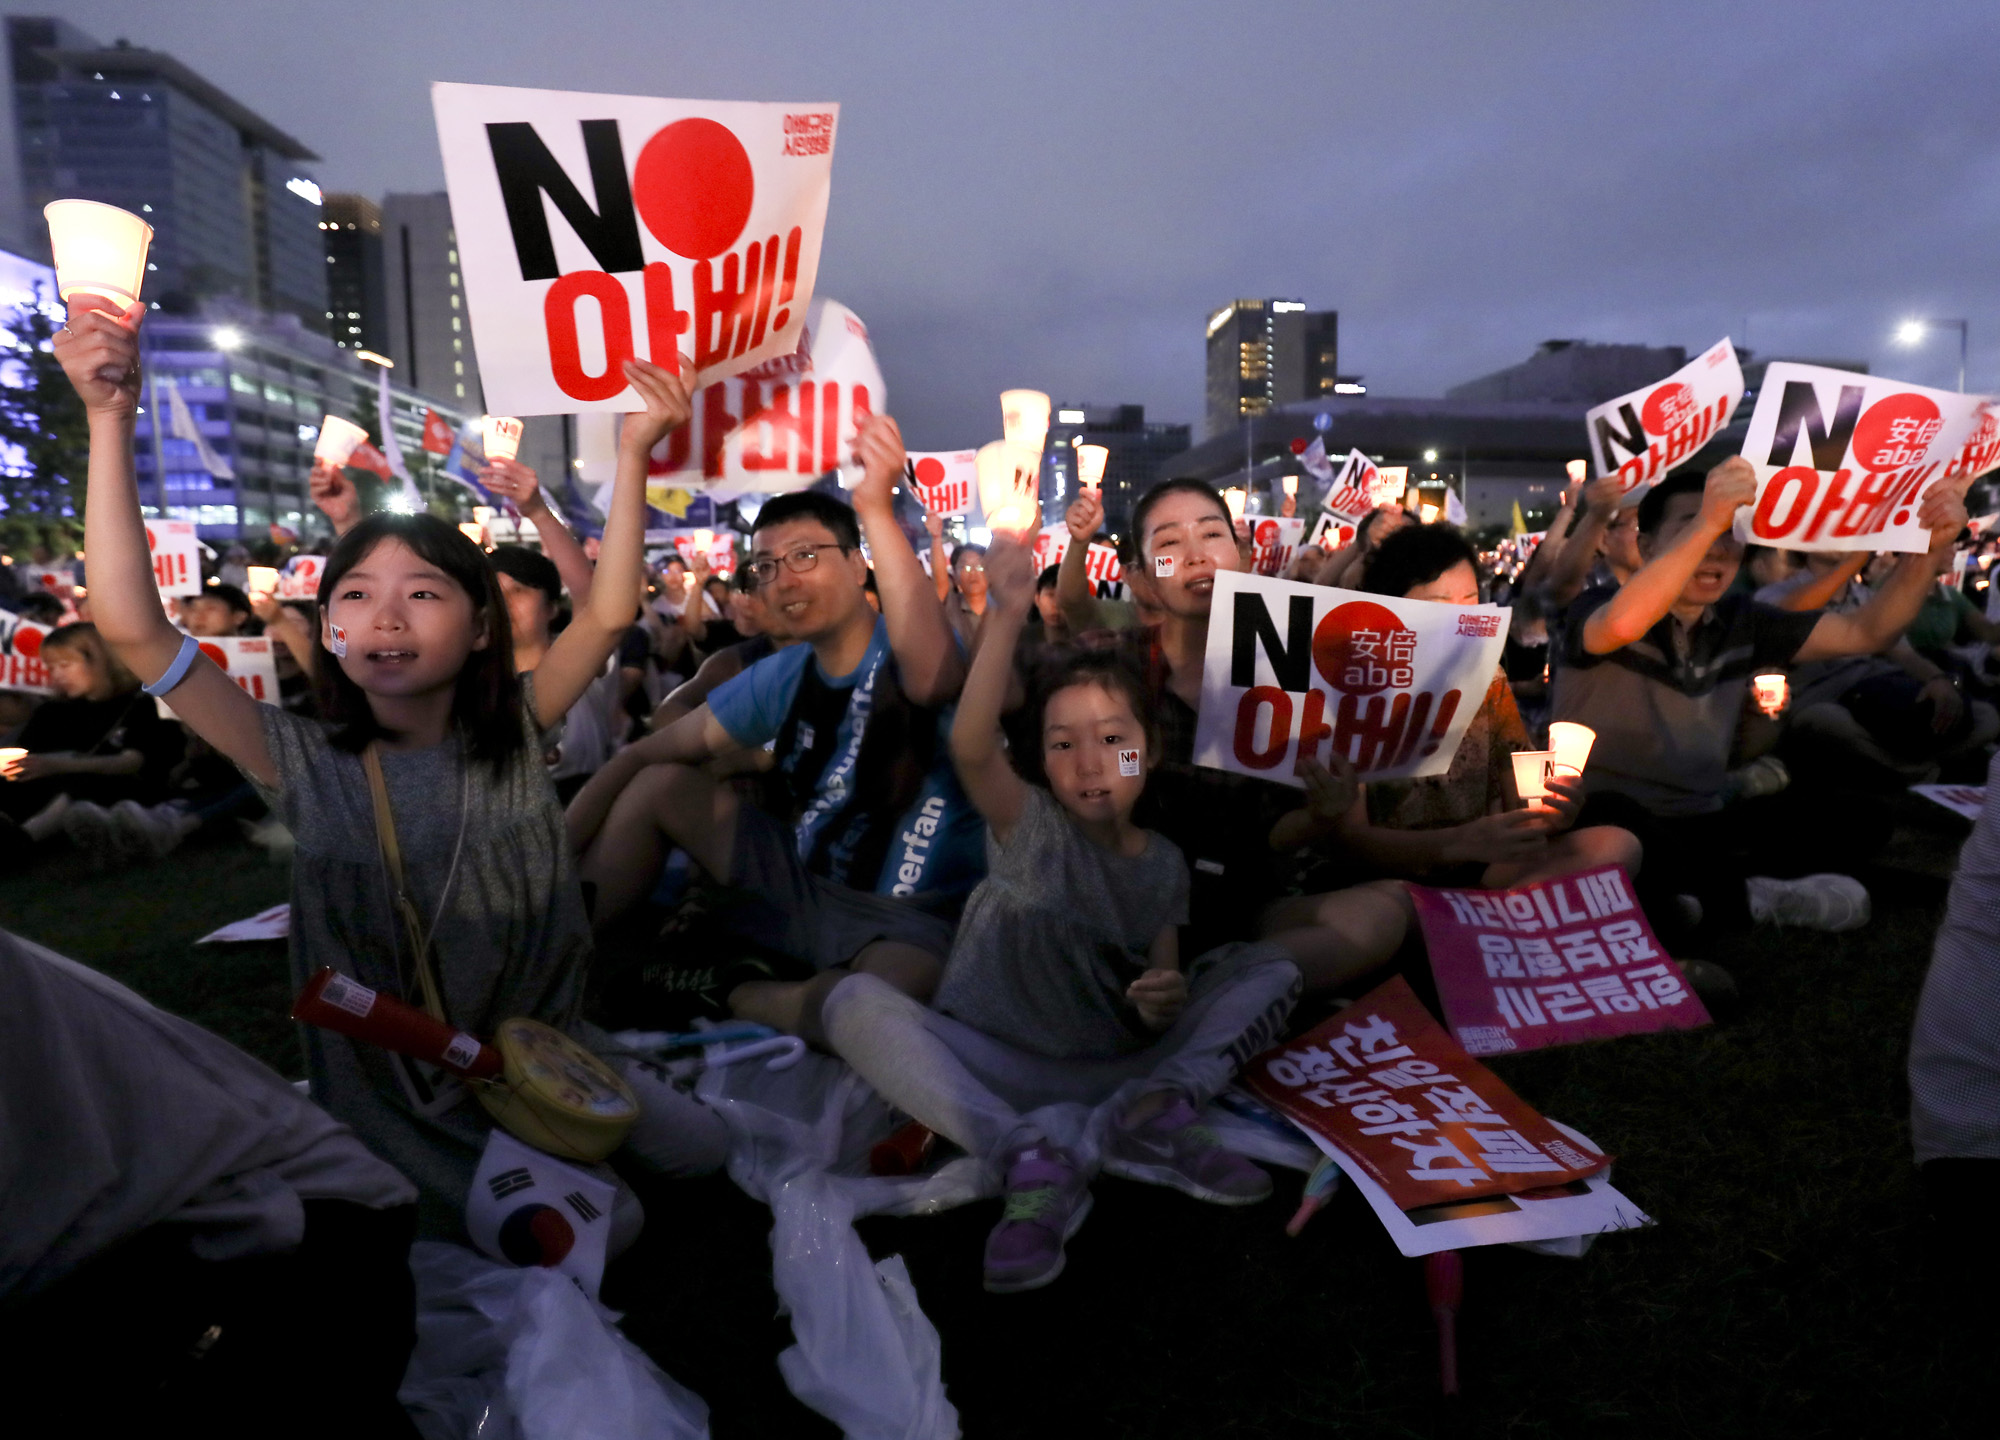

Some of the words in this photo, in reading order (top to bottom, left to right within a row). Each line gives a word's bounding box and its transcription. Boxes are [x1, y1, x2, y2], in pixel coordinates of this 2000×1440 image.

[484, 117, 755, 281] NO
[544, 225, 802, 402] 아베!
[1616, 395, 1729, 494] 아베!
[1767, 380, 1940, 473] NO
[1872, 445, 1928, 466] abe
[1886, 417, 1946, 444] 安倍
[1752, 460, 1941, 543] 아베!
[1158, 558, 1172, 566] NO
[331, 626, 345, 642] NO
[1231, 591, 1408, 696] NO
[1344, 661, 1413, 688] abe
[1350, 628, 1416, 662] 安倍
[1121, 751, 1138, 763] NO
[1233, 685, 1462, 778] 아베!
[1493, 963, 1689, 1030] 한일군사
[1266, 1048, 1493, 1187] 청산하자
[1344, 1014, 1569, 1172] 친일적폐
